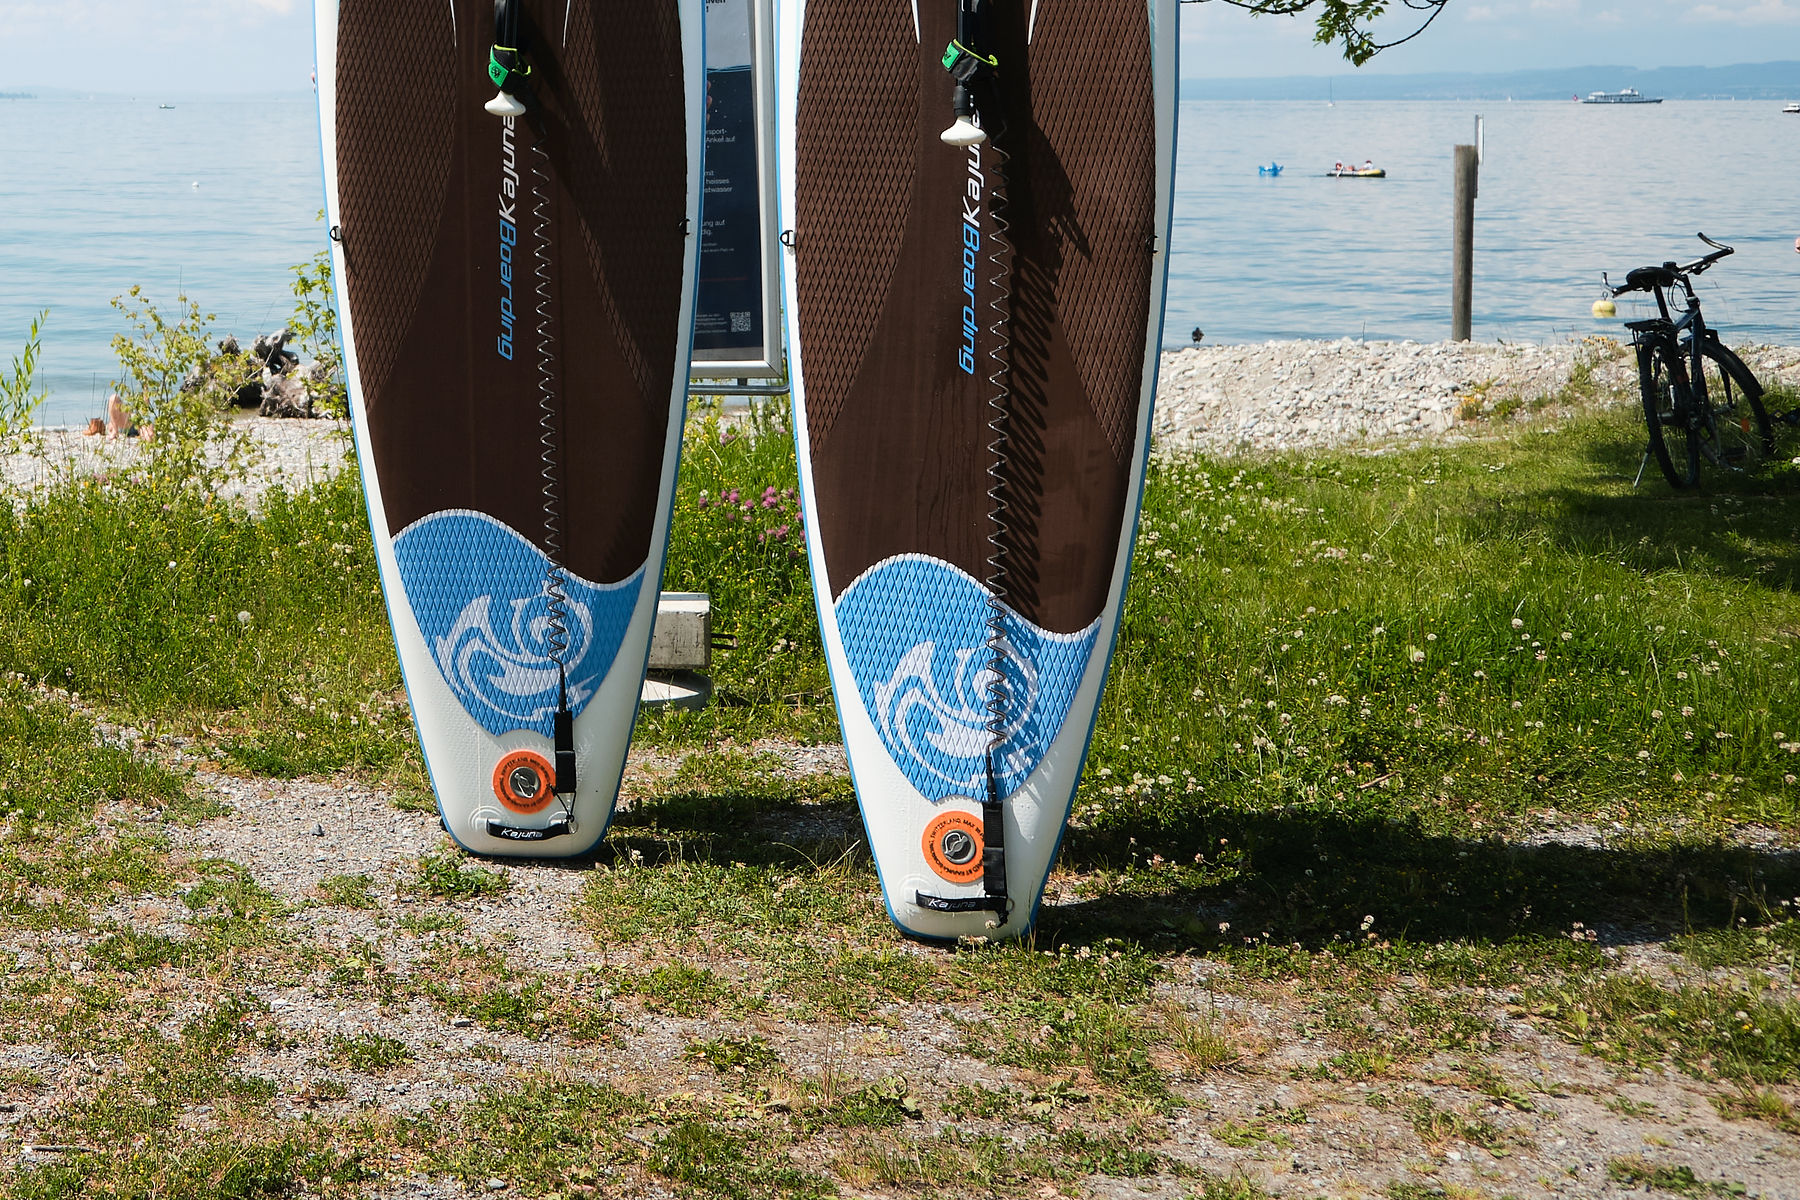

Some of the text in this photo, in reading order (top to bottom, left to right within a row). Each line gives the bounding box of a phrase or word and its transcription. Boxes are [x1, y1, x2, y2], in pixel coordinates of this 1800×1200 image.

[497, 219, 518, 360] Boarding
[958, 222, 981, 375] Boarding
[501, 828, 543, 838] Kajuna
[928, 898, 976, 910] Kajuna
